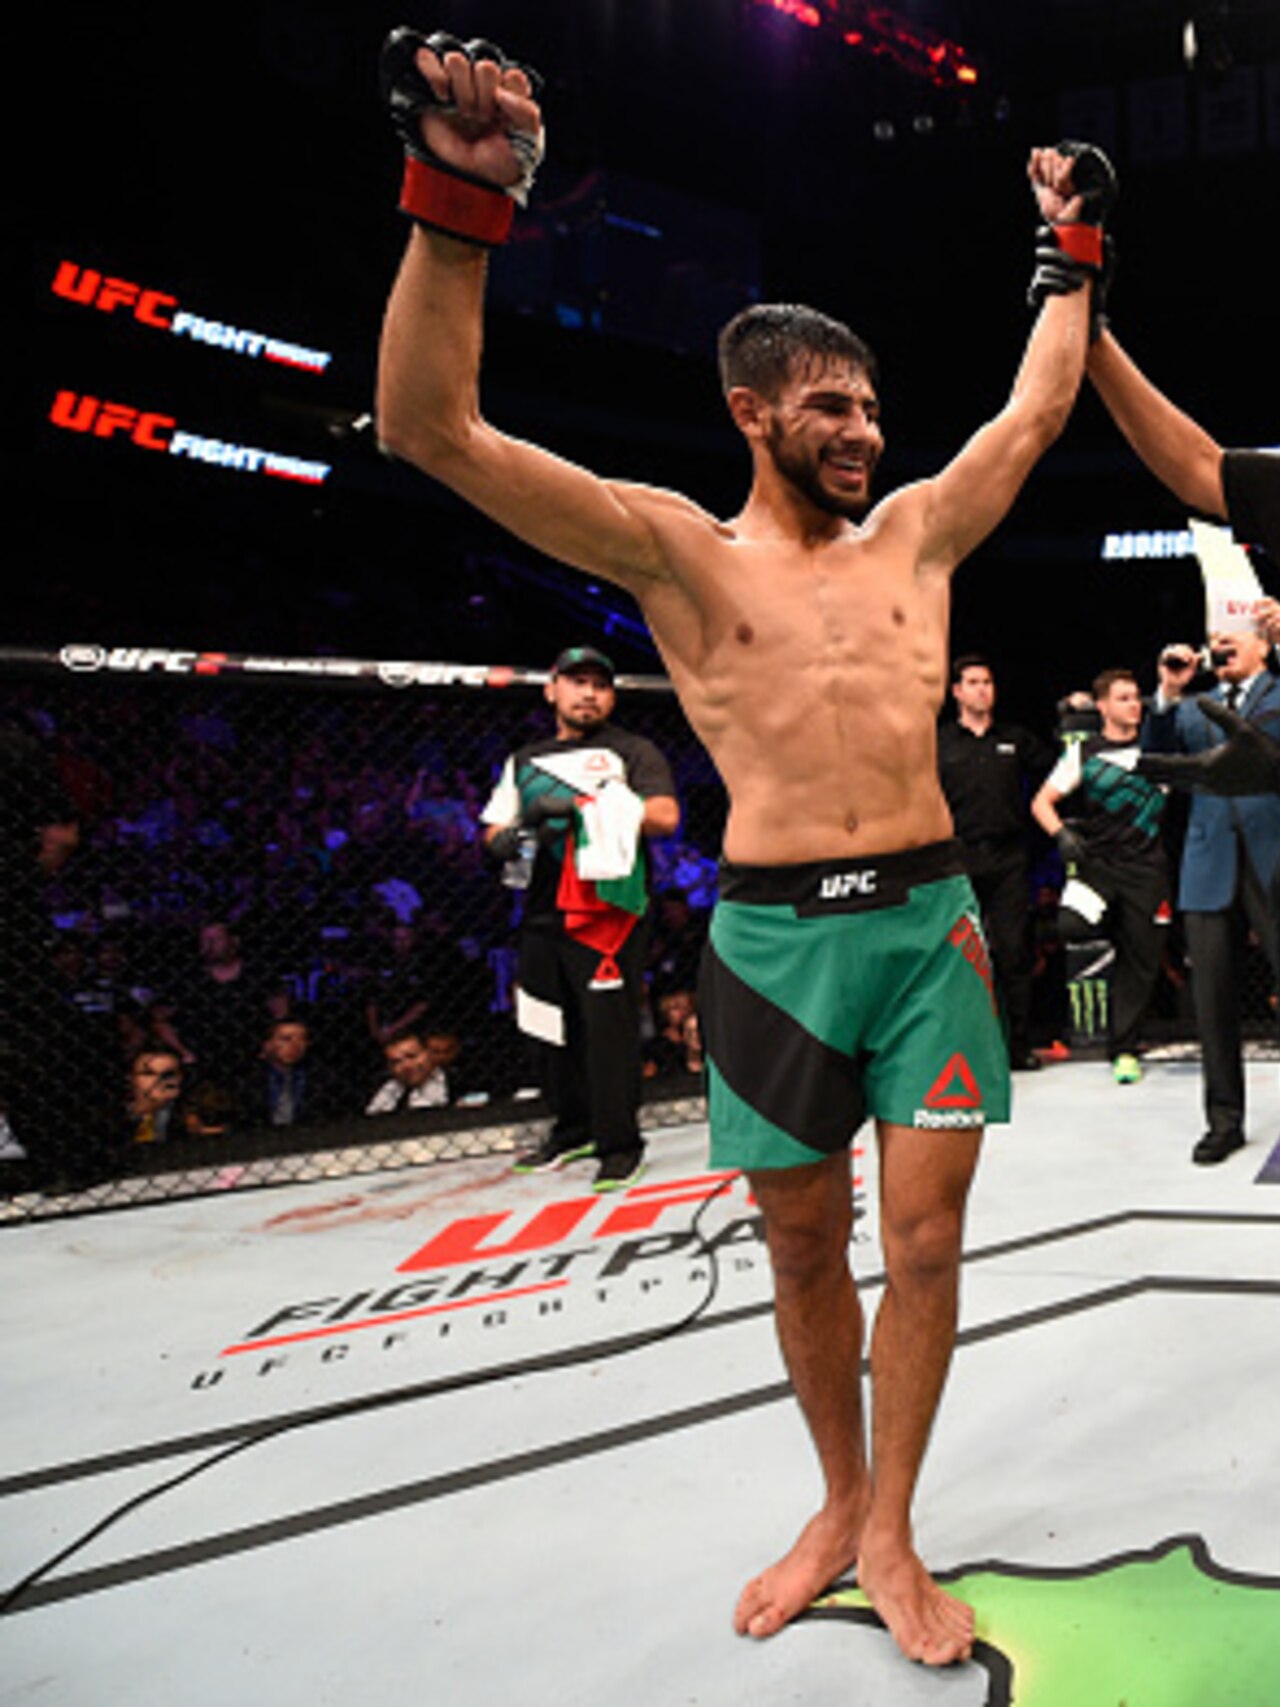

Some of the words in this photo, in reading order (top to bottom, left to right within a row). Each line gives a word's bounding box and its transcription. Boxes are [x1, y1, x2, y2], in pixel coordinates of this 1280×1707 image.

[51, 260, 178, 329] UFC
[171, 310, 266, 357] FIGHT
[50, 390, 176, 451] UFC
[169, 430, 266, 472] FIGHT
[107, 647, 197, 671] UFC
[818, 869, 877, 898] UFC
[397, 1148, 866, 1272] UF
[244, 1245, 603, 1341] FIGHT
